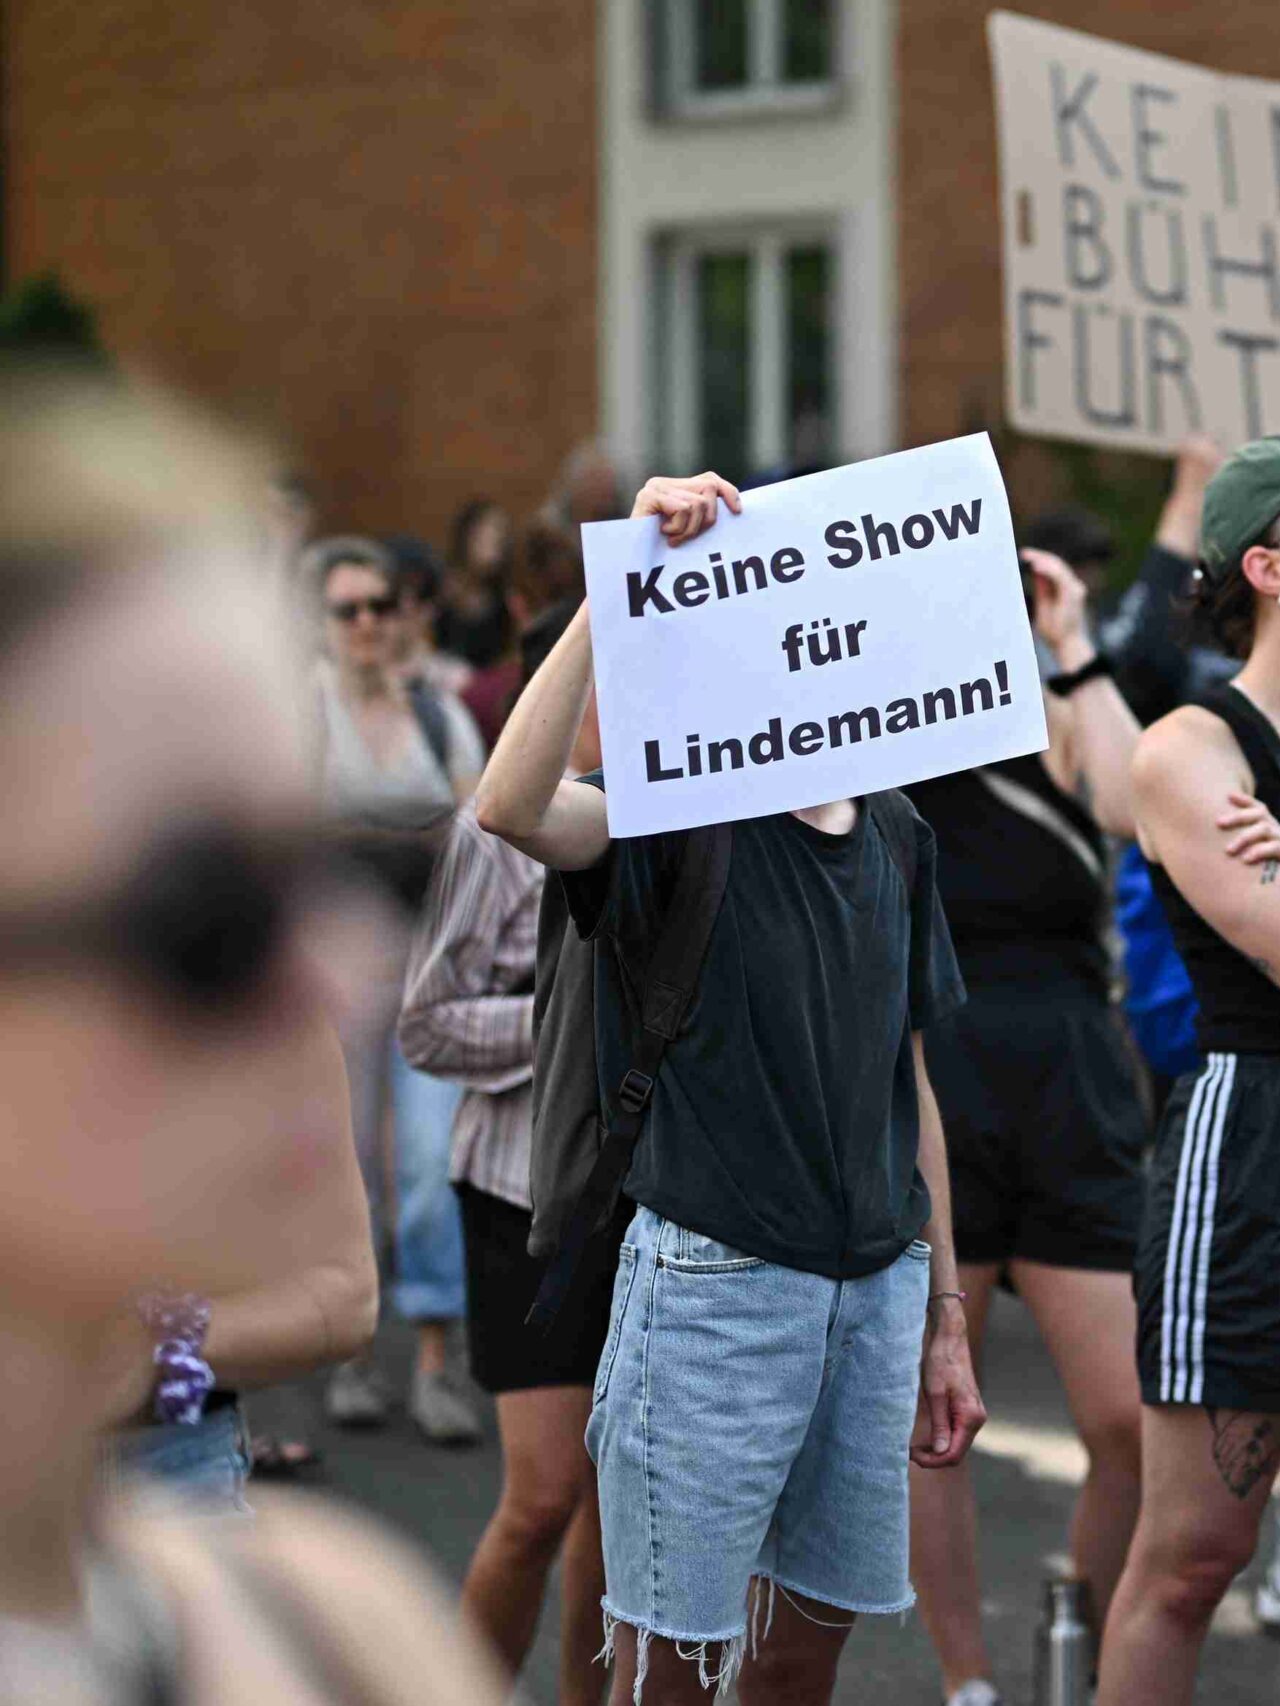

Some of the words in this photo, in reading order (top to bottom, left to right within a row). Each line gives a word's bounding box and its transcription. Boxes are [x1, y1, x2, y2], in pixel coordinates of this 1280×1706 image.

[1017, 287, 1204, 435] FÜR
[626, 546, 805, 618] Keine
[823, 498, 983, 570] Show
[781, 617, 868, 673] für
[643, 659, 1013, 783] Lindemann!
